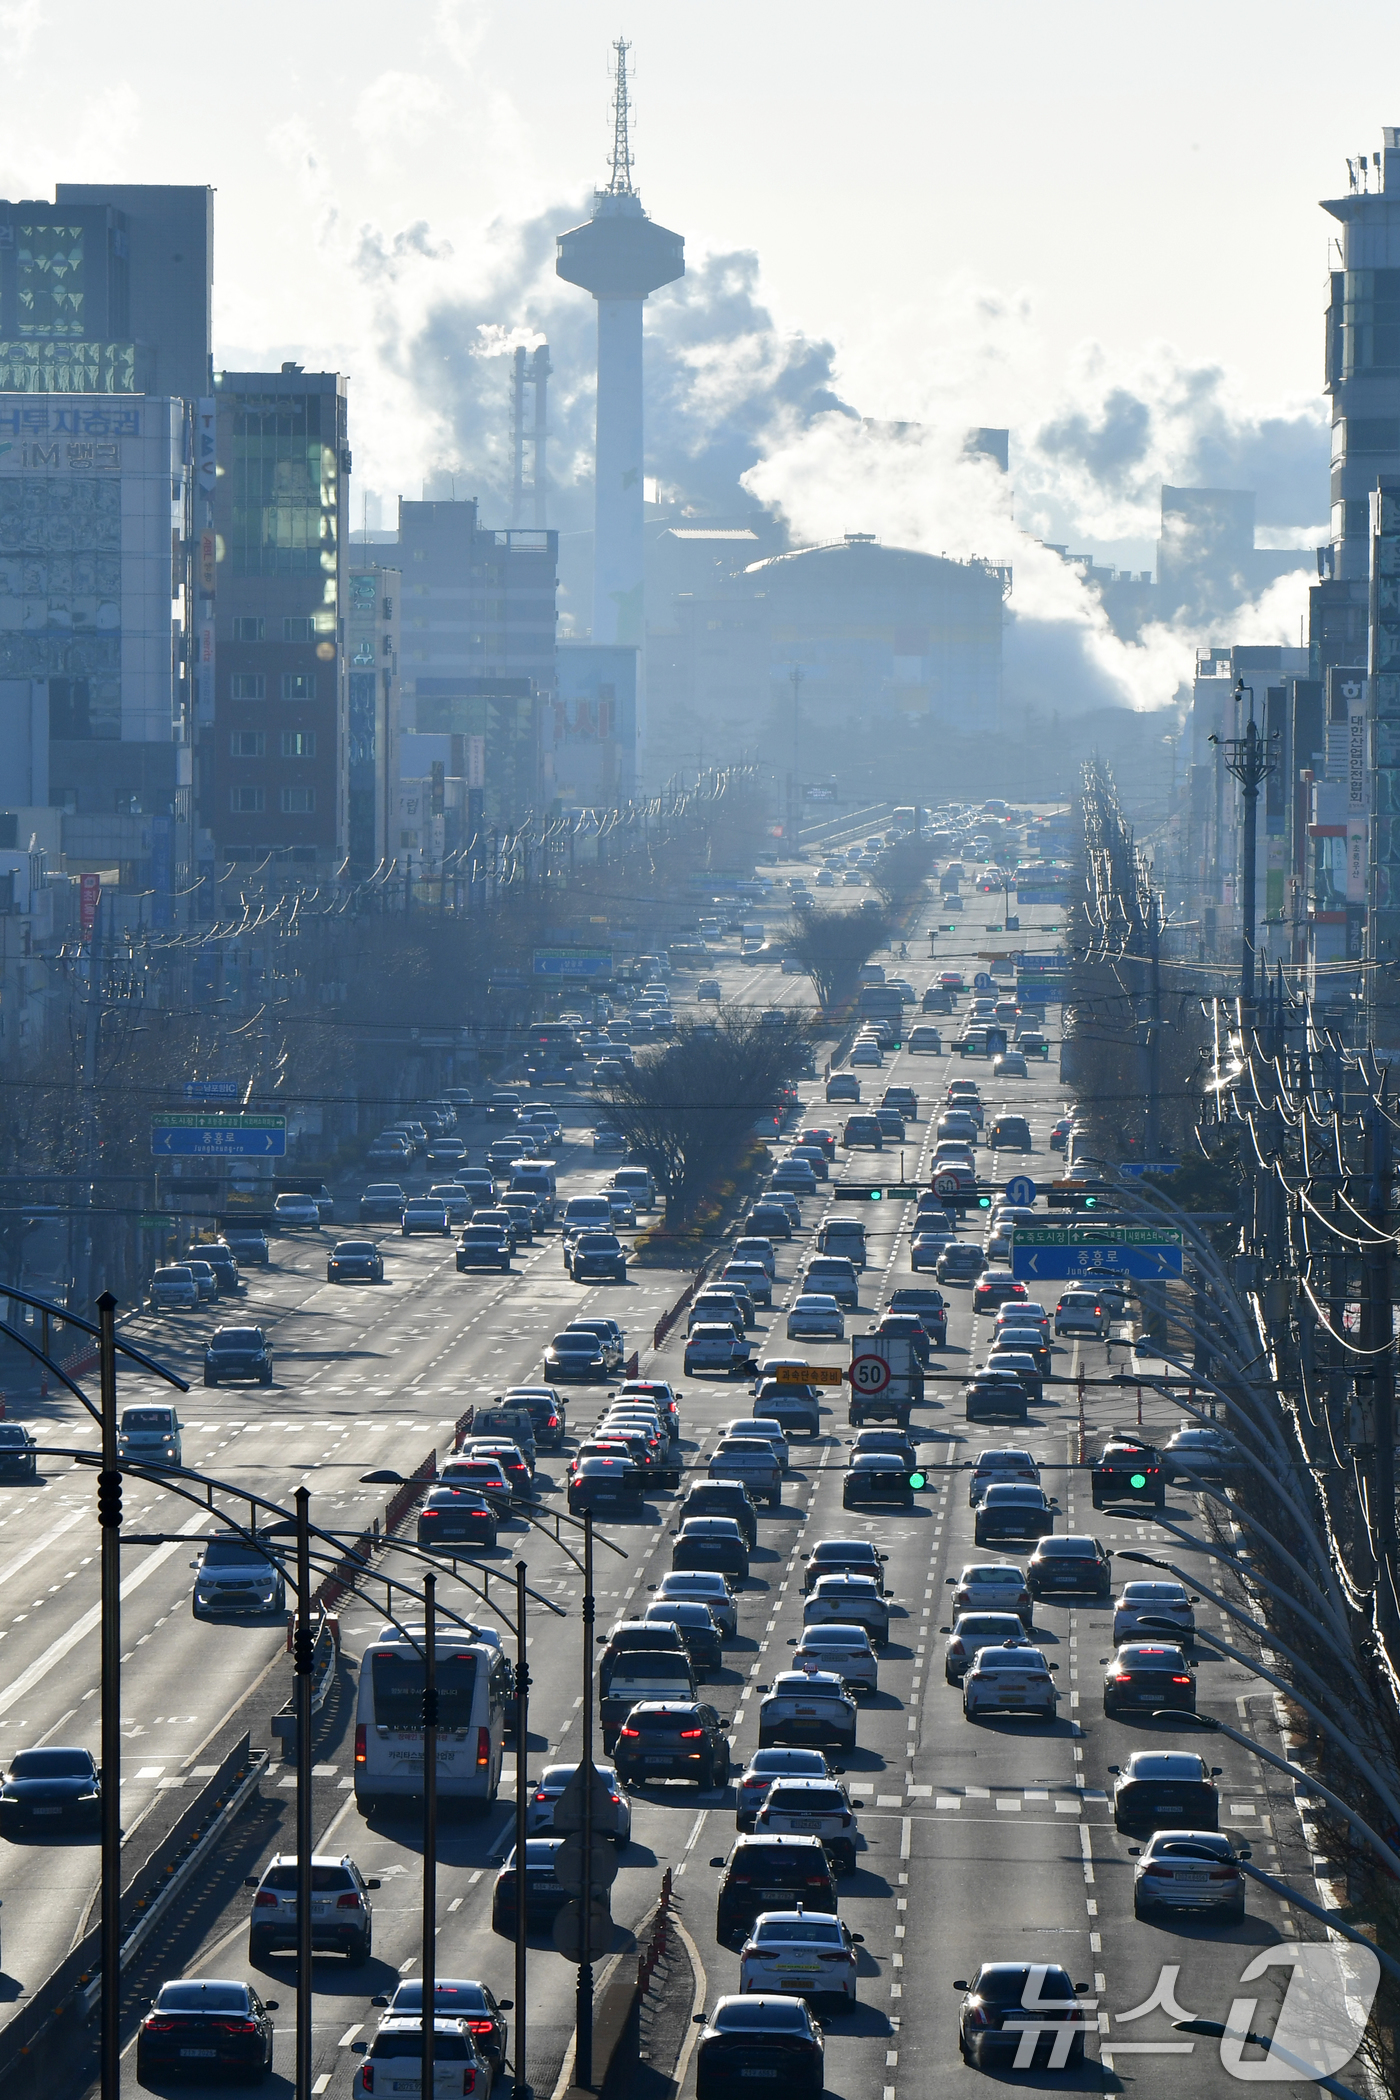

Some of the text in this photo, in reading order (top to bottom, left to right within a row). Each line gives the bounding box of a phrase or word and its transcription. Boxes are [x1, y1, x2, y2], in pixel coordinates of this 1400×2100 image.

[22, 441, 121, 470] iM 뱅크
[203, 630, 213, 663] meritz
[554, 702, 610, 739] 시
[1350, 715, 1364, 803] 대한산업안전협회
[1350, 919, 1360, 951] PING
[162, 1117, 194, 1126] 죽도시장
[202, 1132, 235, 1145] 중흥로
[938, 1180, 954, 1190] 50
[1026, 1232, 1066, 1243] 죽도시장
[1077, 1250, 1119, 1266] 중흥로
[1066, 1267, 1130, 1277] Jung-ro
[782, 1369, 838, 1383] 과속단속장비
[859, 1365, 881, 1384] 50
[388, 1751, 456, 1761] 카리타스보업장
